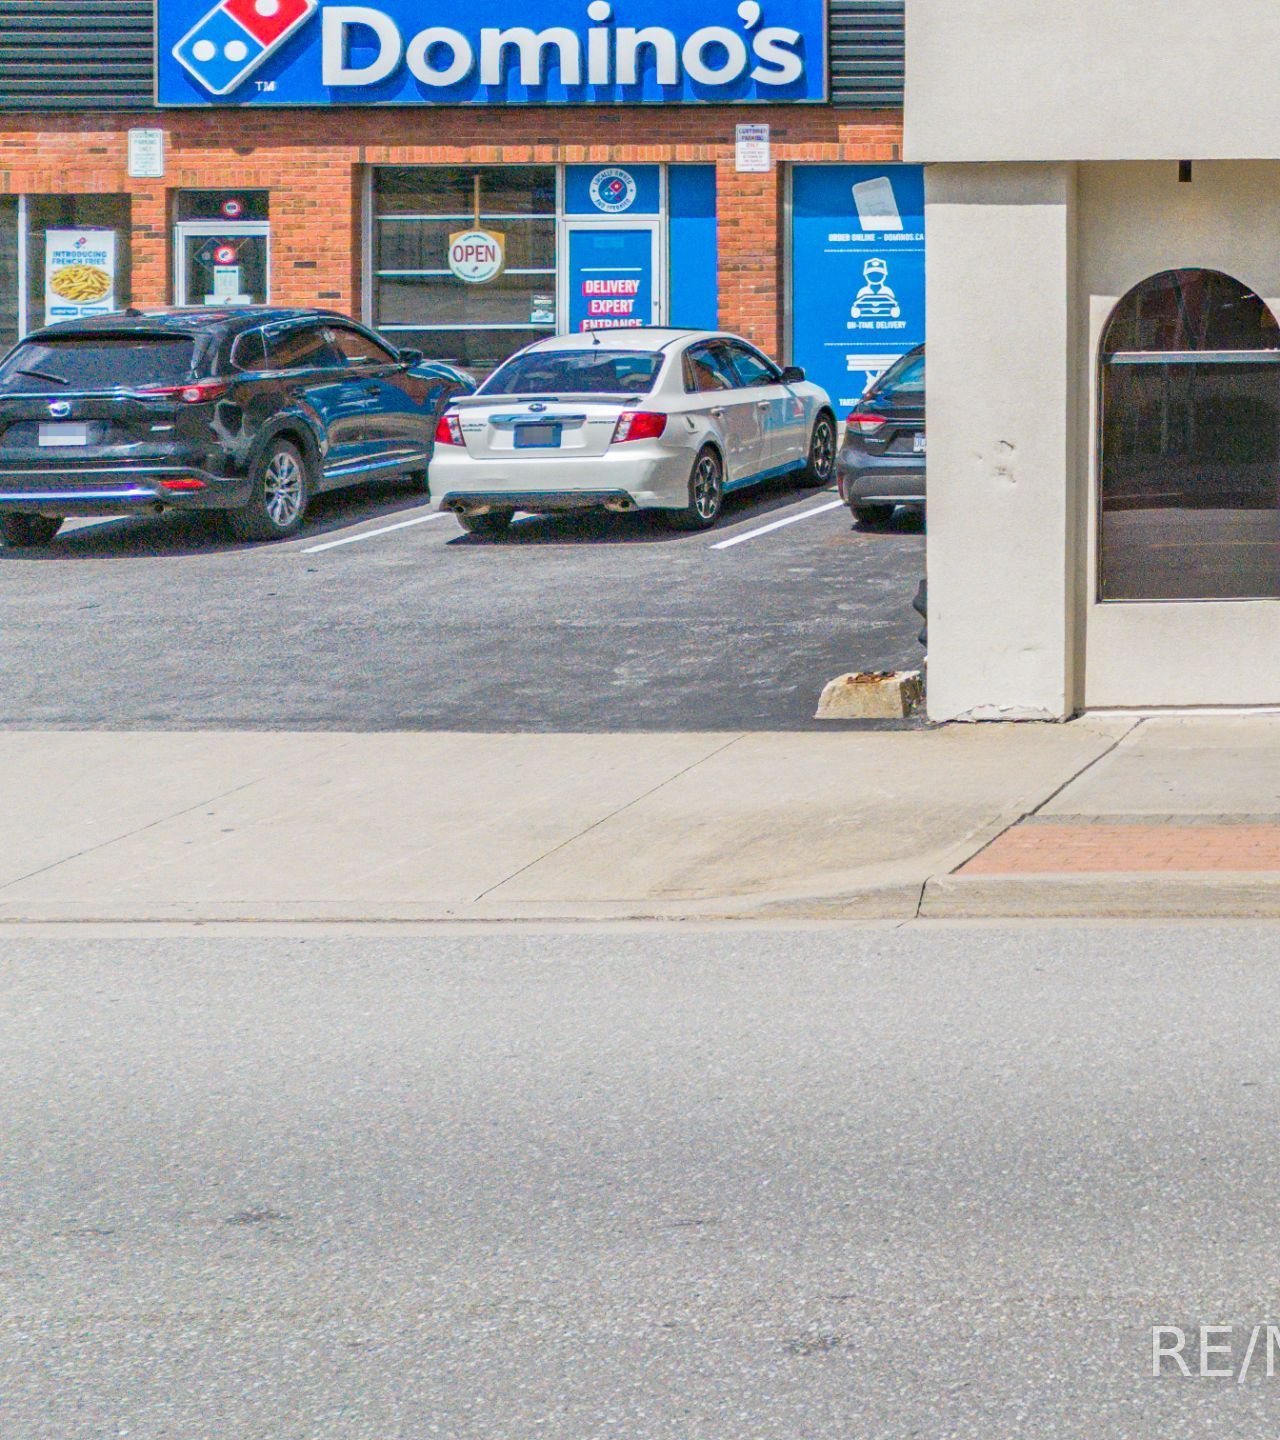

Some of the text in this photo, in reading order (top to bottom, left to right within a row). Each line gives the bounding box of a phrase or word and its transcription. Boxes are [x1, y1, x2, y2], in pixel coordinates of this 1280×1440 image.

[321, 0, 803, 86] Domino's
[255, 81, 277, 92] TM
[53, 250, 107, 258] INTRODUCING
[453, 244, 496, 263] OPEN
[584, 279, 640, 295] DELIVERY
[590, 299, 635, 314] EXPERT
[581, 318, 643, 330] ENTRANCE
[875, 321, 906, 329] DELIVERY
